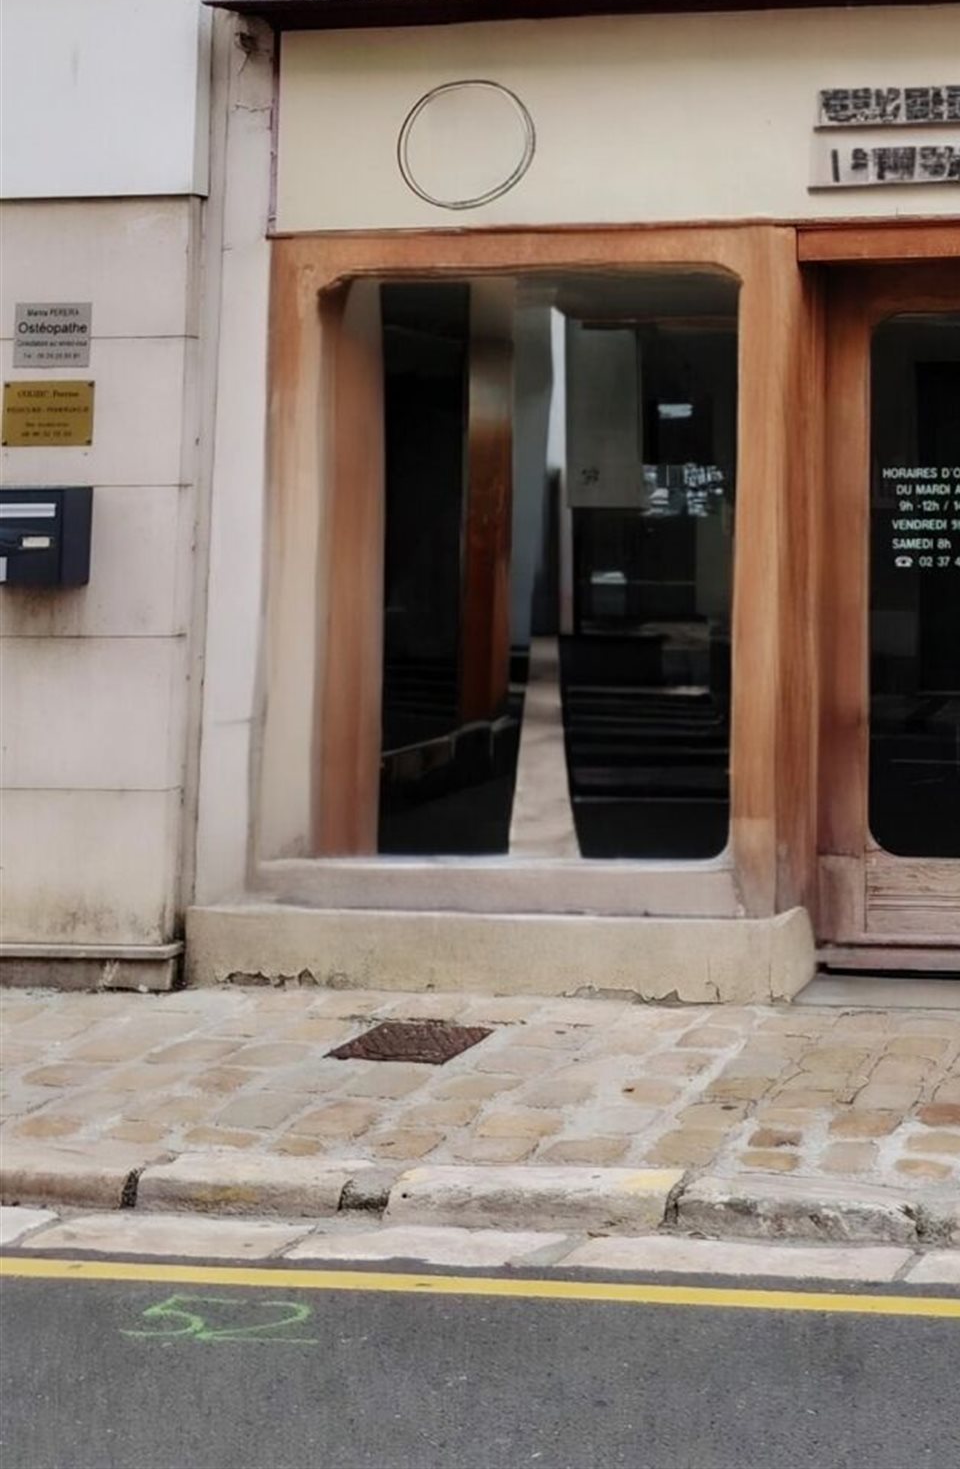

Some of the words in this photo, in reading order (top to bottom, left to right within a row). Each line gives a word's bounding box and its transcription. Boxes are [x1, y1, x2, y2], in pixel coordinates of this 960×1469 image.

[18, 321, 88, 336] Ostéopathe
[882, 467, 938, 479] HORAIRES
[896, 484, 912, 495] DU
[915, 484, 951, 495] MARDI
[899, 500, 914, 511] 9h
[891, 519, 947, 530] VENDREDI
[892, 538, 934, 549] SAMEDI
[937, 538, 952, 549] 8h
[918, 556, 933, 567] 02
[937, 556, 950, 567] 37
